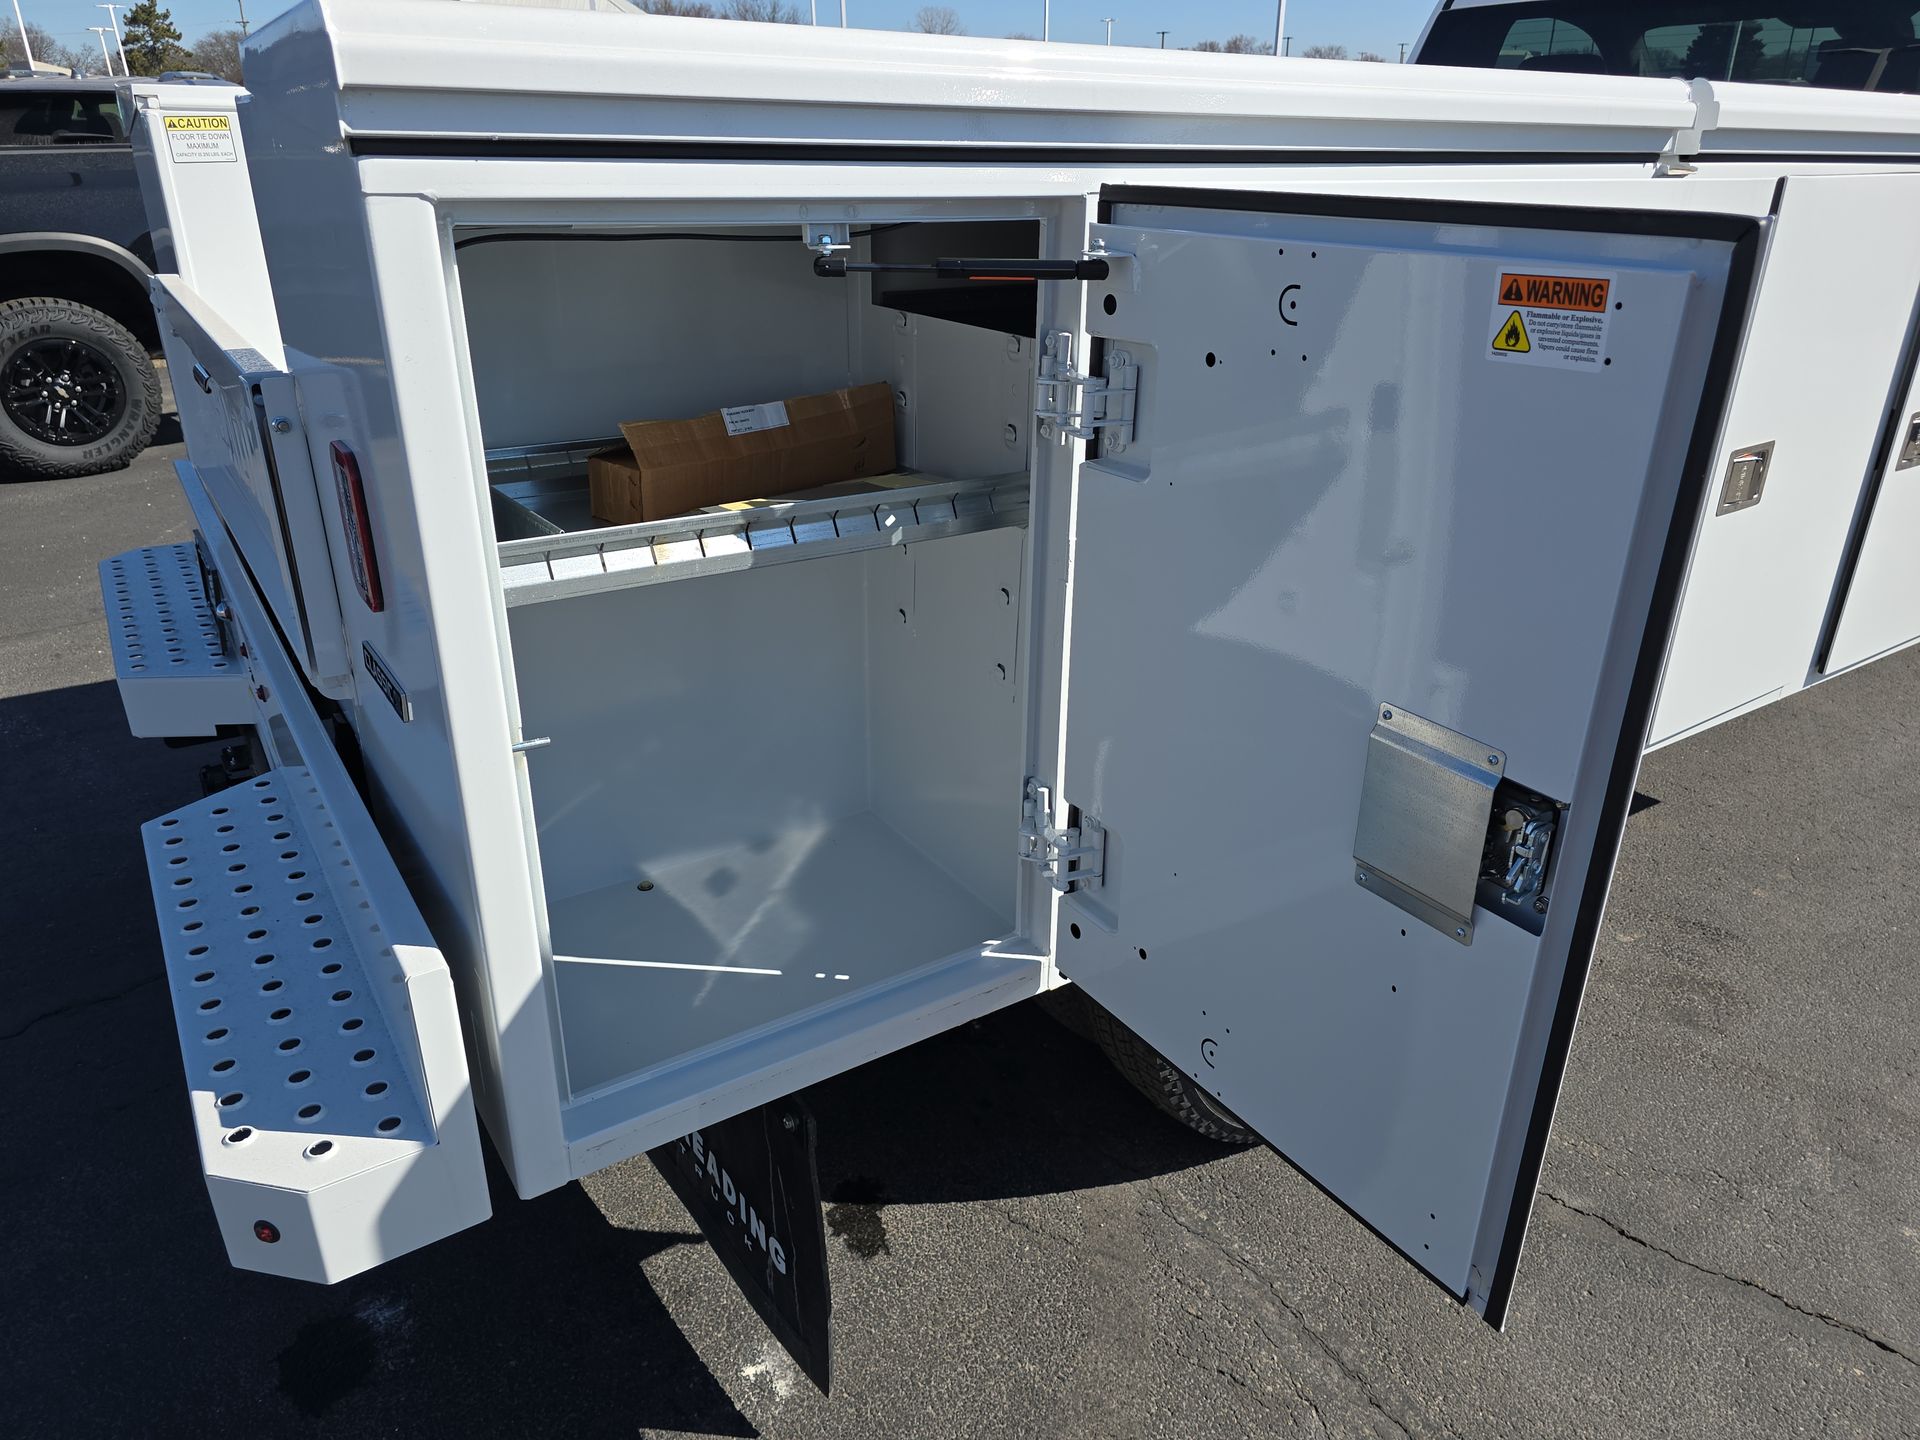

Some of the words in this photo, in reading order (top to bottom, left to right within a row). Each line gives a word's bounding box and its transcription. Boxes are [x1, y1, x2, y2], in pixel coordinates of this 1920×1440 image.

[177, 118, 228, 129] CAUTION
[171, 133, 196, 141] FLOOR
[1526, 279, 1605, 308] WARNING
[1526, 310, 1561, 321] Flammable
[1570, 314, 1604, 324] Explosive.
[1536, 328, 1561, 336] explosive
[82, 398, 143, 460] WRANGLER
[679, 1142, 753, 1252] TRUCK
